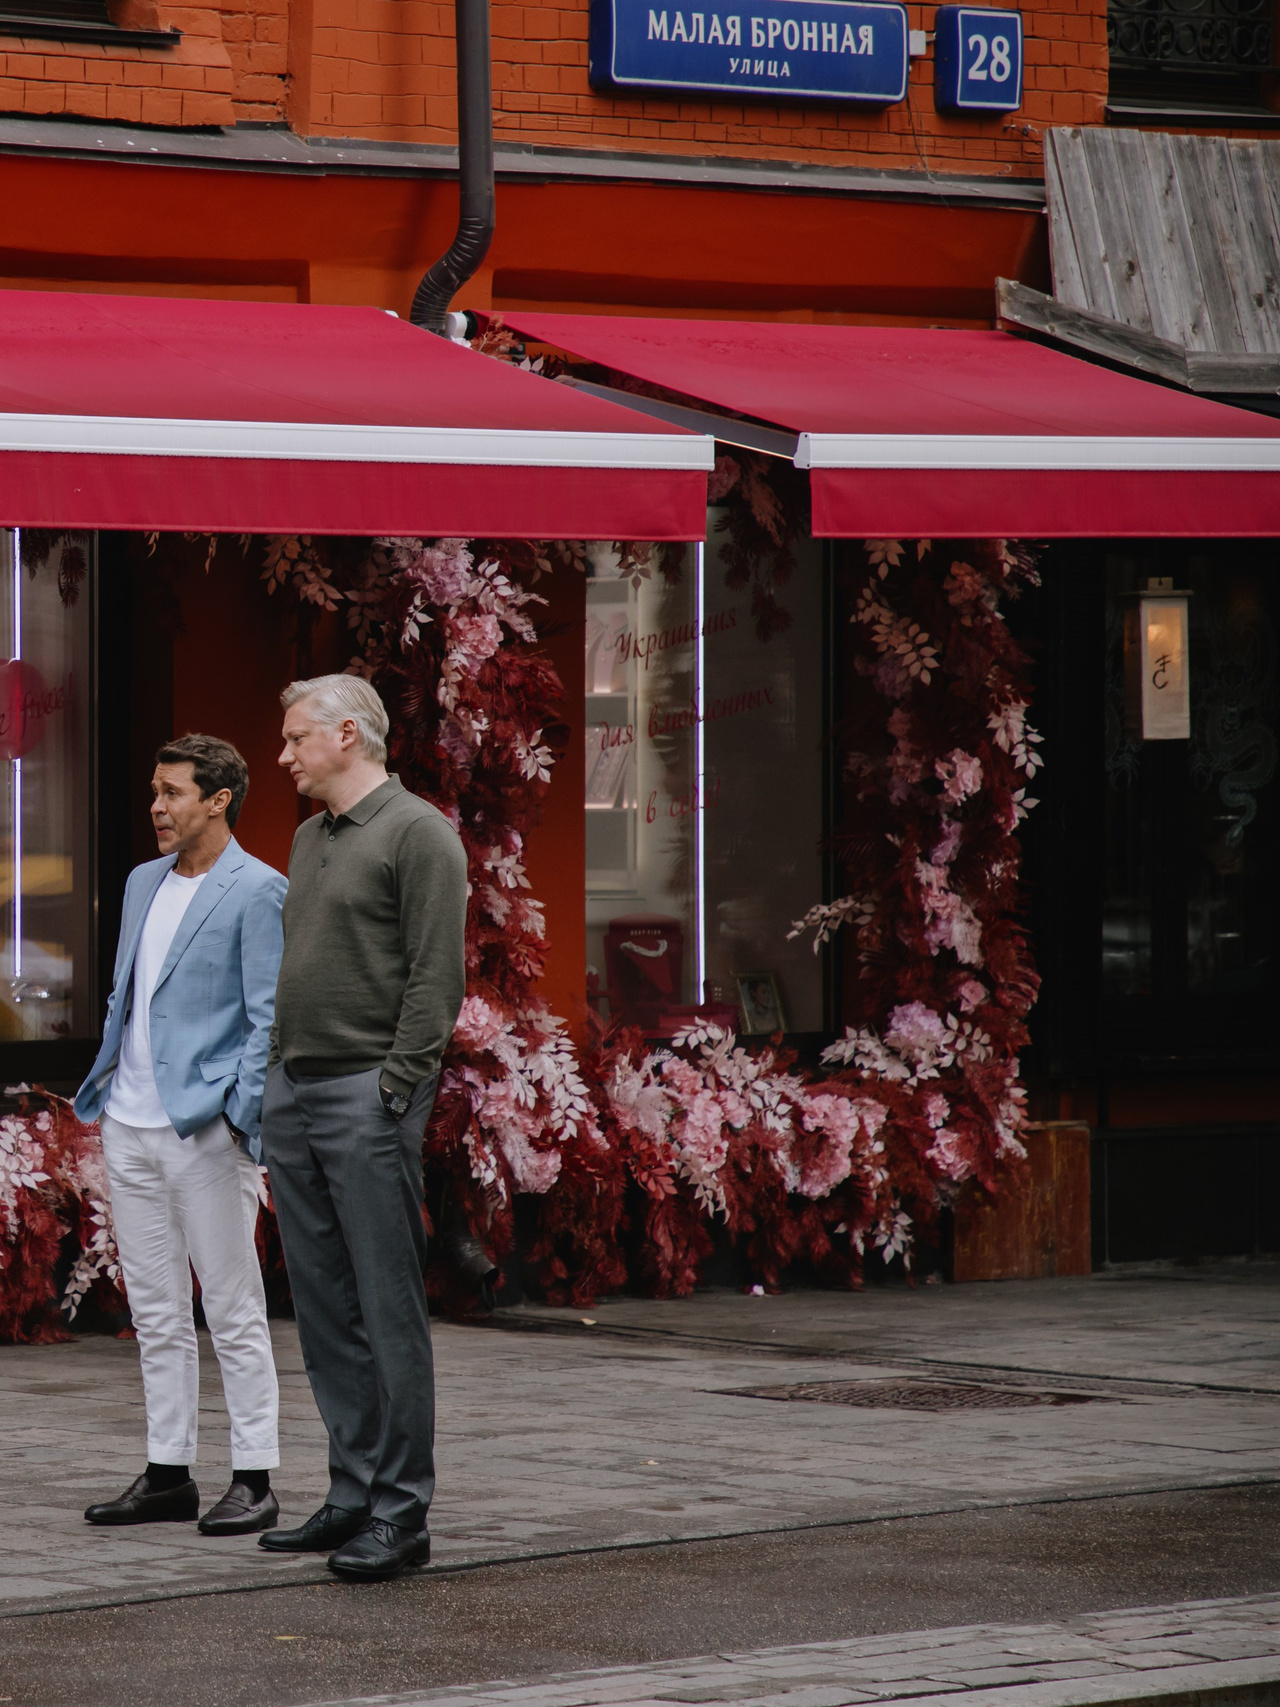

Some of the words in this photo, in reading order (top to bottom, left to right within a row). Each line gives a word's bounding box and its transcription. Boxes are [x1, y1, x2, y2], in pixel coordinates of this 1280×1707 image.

[647, 9, 742, 47] МАЛАЯ
[751, 18, 875, 56] БРОННАЯ
[729, 57, 791, 78] УЛИЦА
[967, 33, 1011, 83] 28
[615, 607, 738, 670] Украшения
[600, 721, 636, 751] для
[646, 790, 658, 824] в
